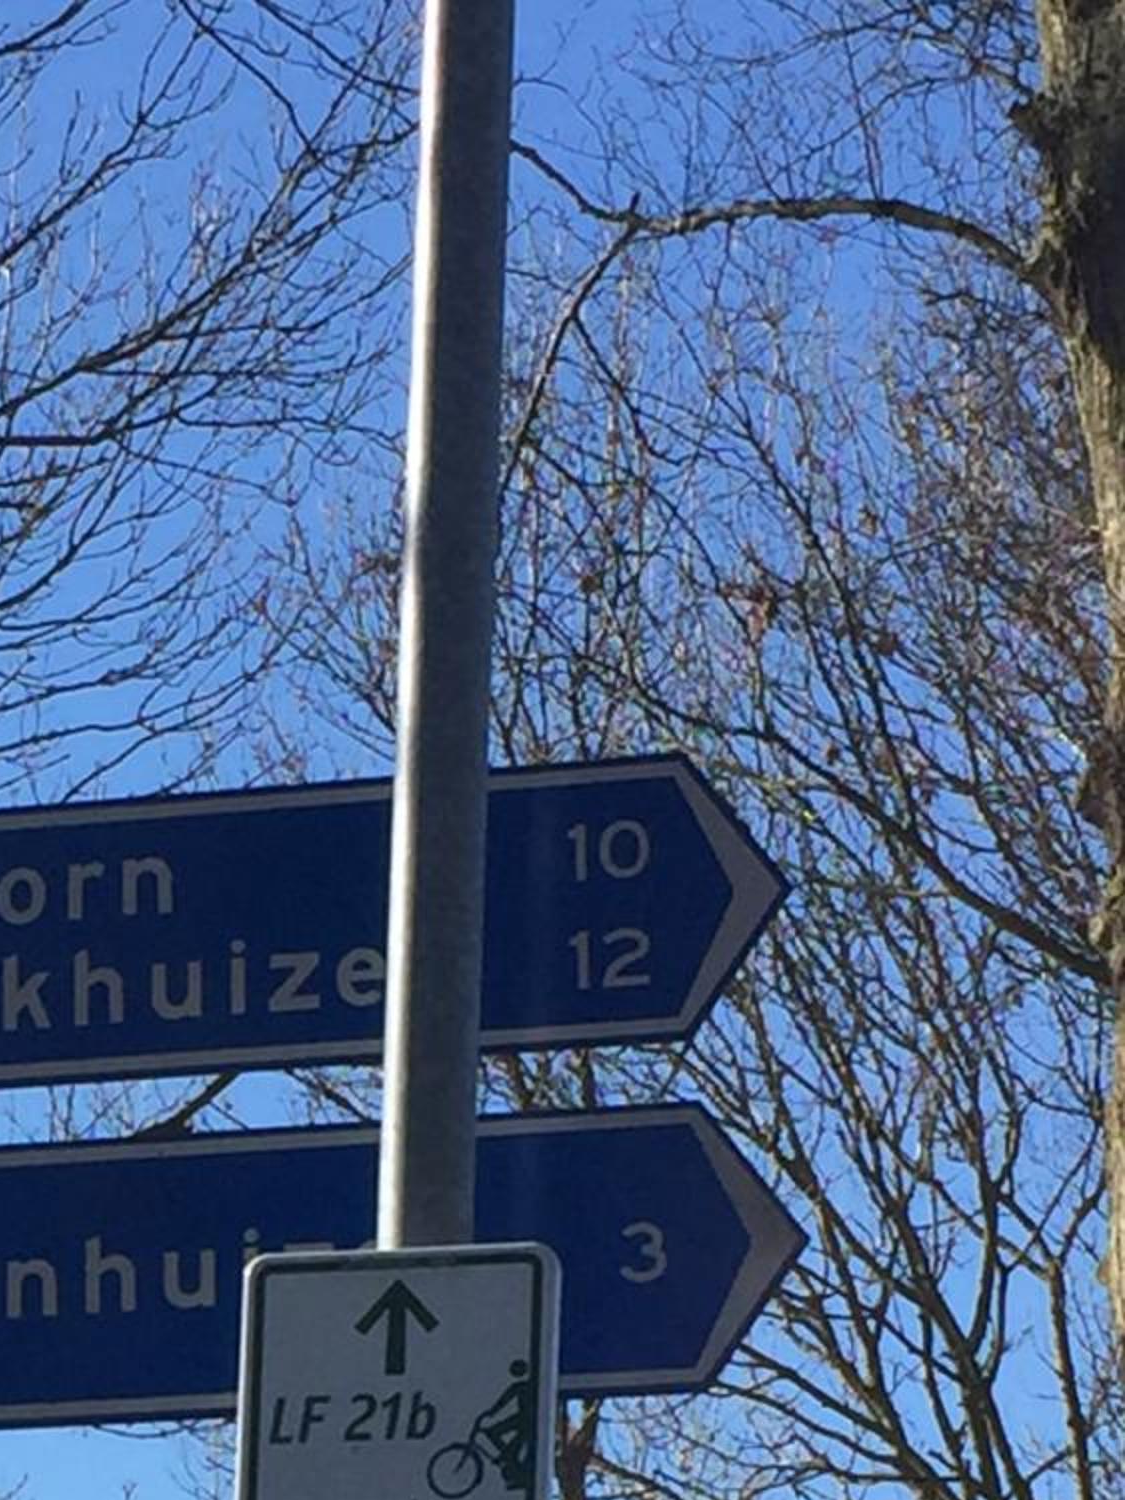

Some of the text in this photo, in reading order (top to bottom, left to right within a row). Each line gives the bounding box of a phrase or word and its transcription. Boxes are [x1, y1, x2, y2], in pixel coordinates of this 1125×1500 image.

[567, 819, 651, 882] 10
[569, 927, 651, 990] 12
[619, 1221, 668, 1284] 3
[269, 1391, 438, 1445] LF 21b
